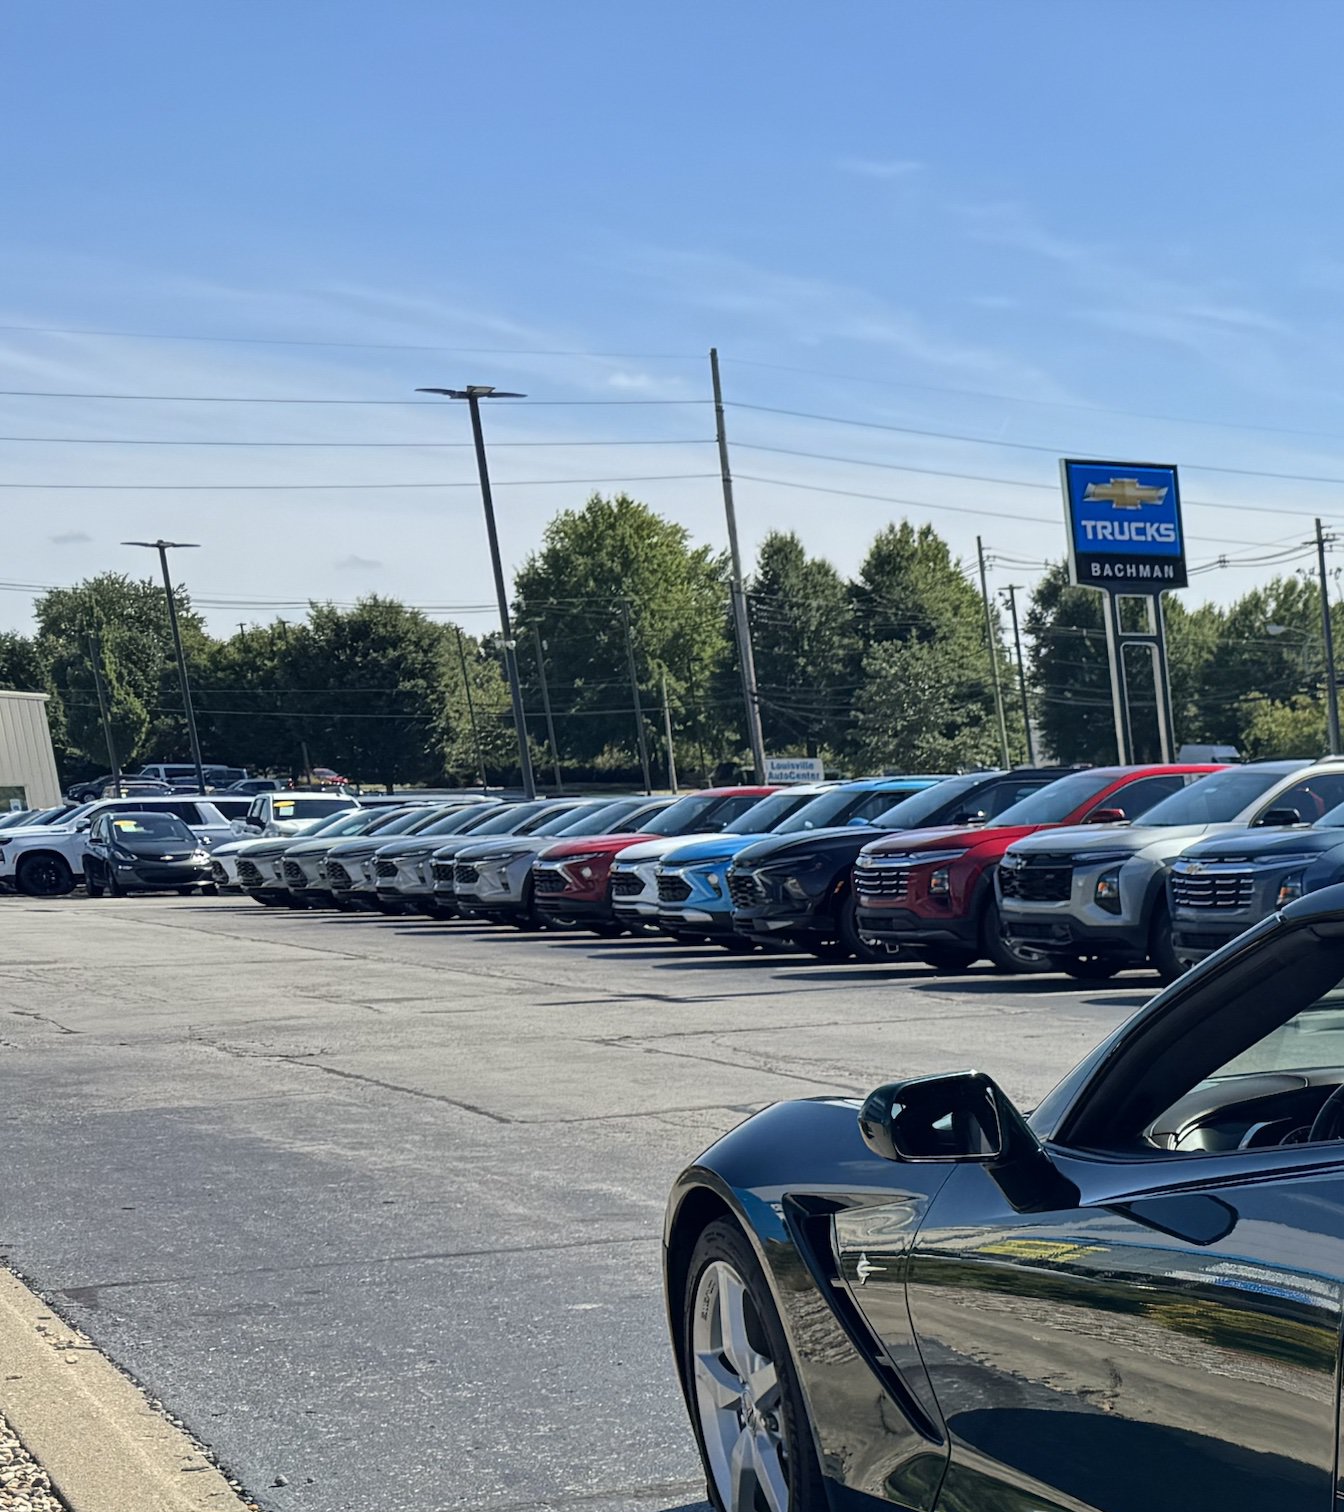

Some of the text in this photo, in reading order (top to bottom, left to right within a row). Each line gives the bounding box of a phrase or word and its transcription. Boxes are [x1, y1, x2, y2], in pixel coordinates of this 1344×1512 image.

[1081, 520, 1176, 542] TRUCKS
[1090, 562, 1174, 578] BACHMAN
[770, 761, 815, 770] Louisville
